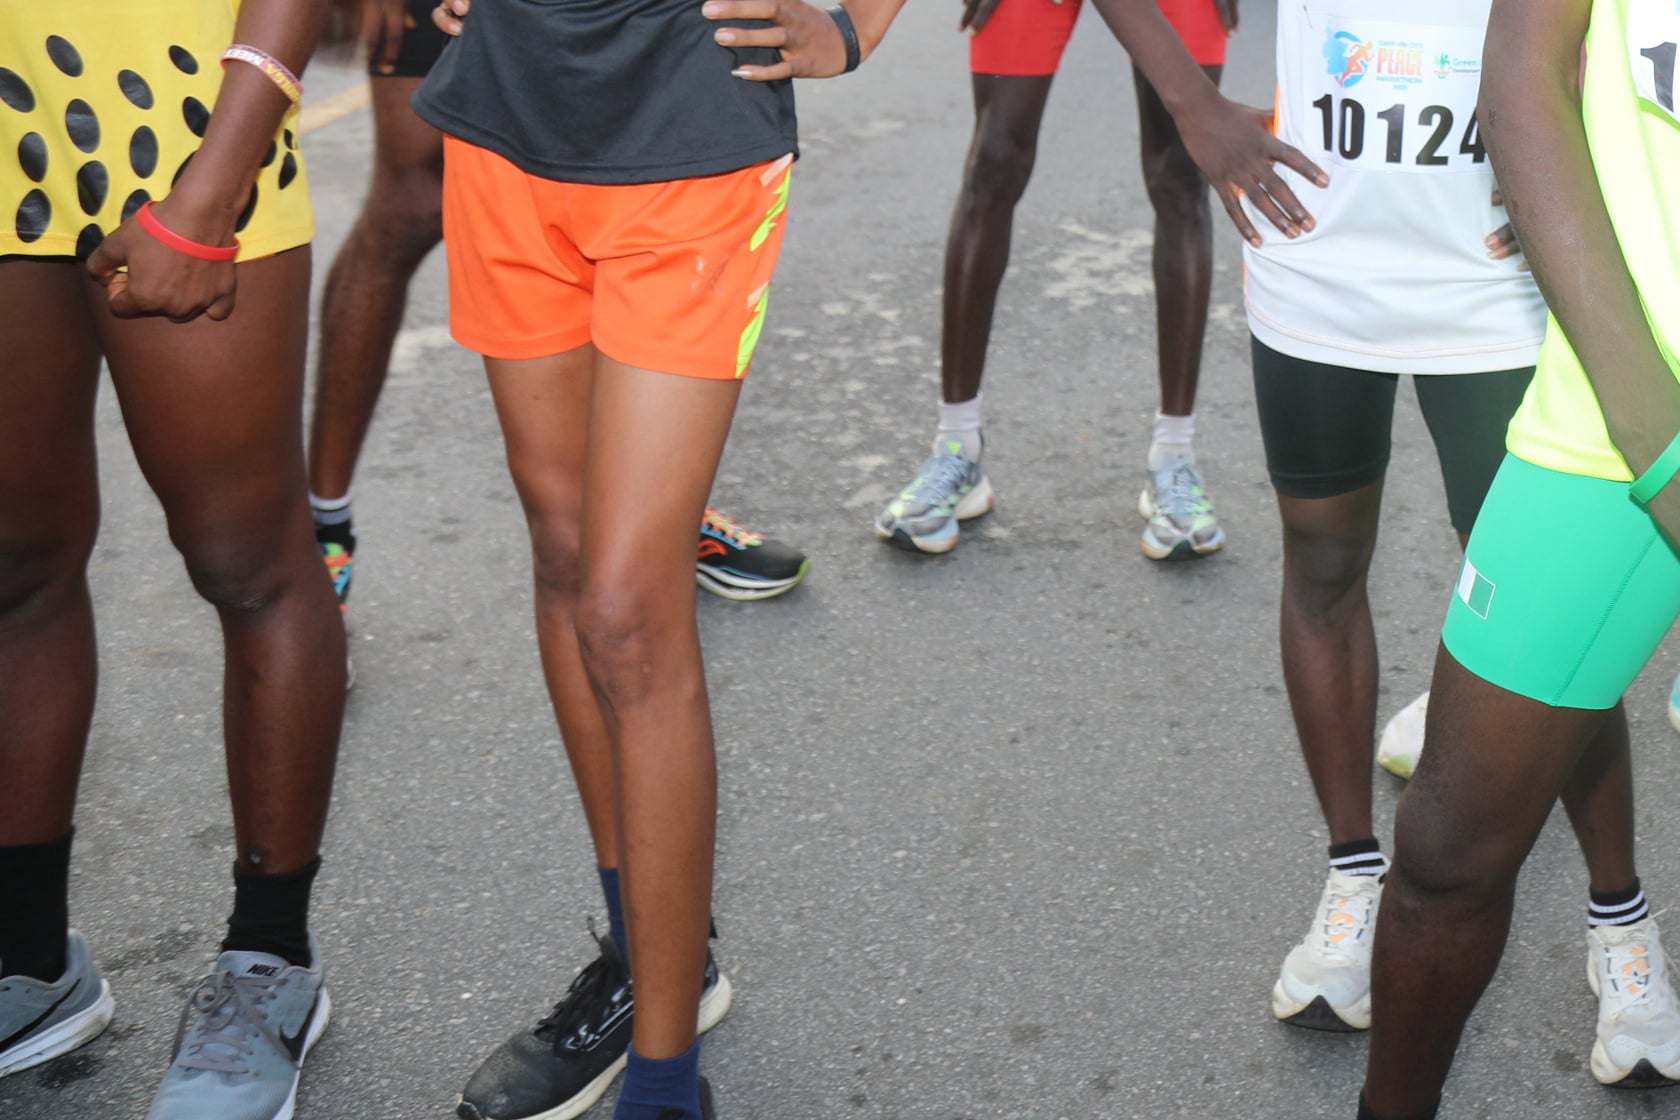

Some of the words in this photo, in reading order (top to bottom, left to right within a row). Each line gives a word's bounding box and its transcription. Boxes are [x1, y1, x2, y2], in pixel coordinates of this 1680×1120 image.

[1376, 47, 1423, 76] PEACE
[1452, 58, 1478, 66] Green
[1312, 93, 1487, 166] 10124
[246, 963, 281, 977] NIKE
